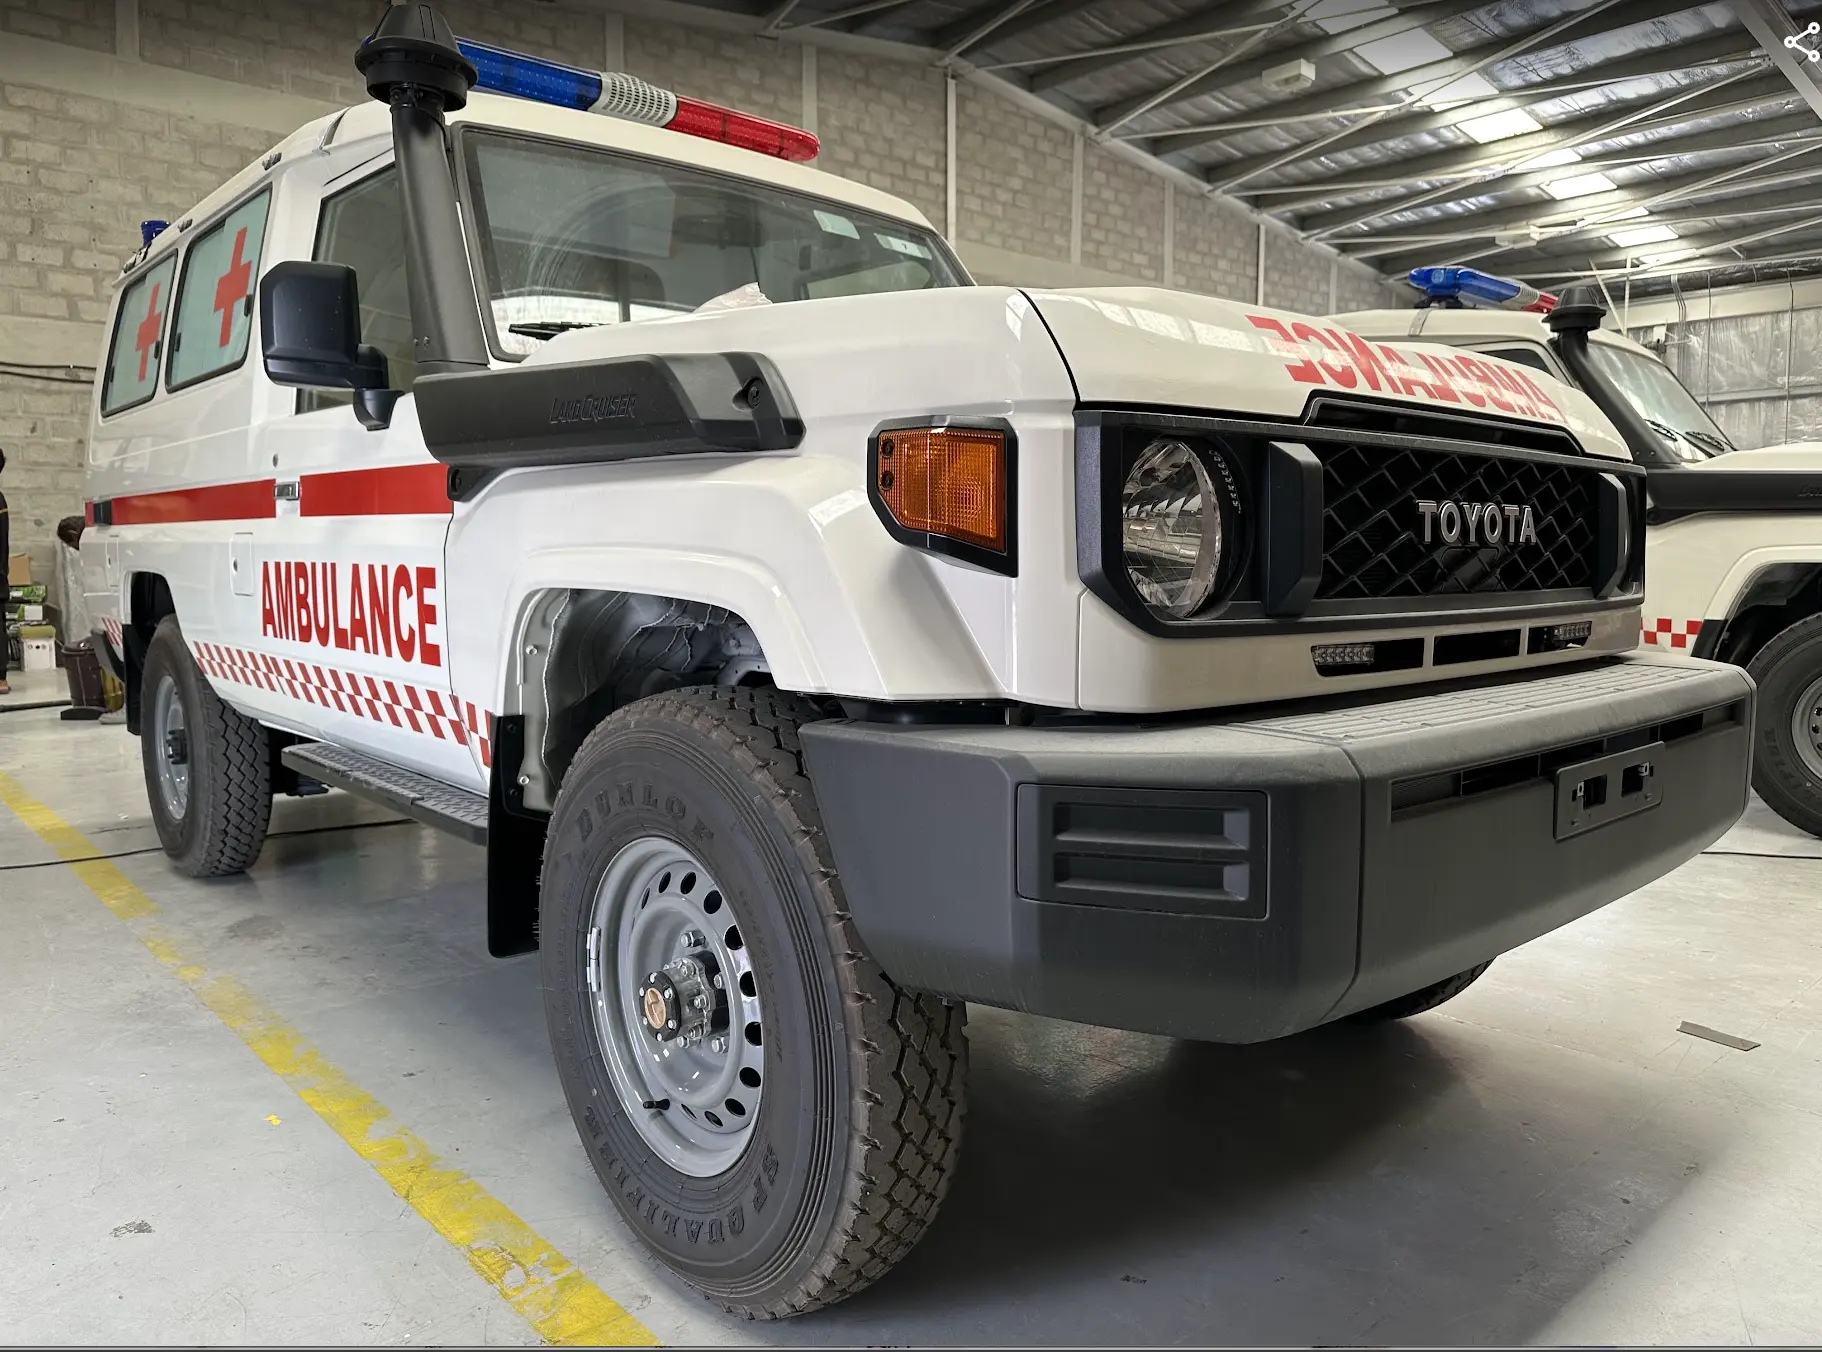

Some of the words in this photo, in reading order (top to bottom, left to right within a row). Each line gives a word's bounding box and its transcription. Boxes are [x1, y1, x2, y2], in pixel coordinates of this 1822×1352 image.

[1415, 499, 1538, 547] TOYOTA
[262, 560, 442, 667] AMBULANCE
[575, 778, 715, 842] DUNLOP
